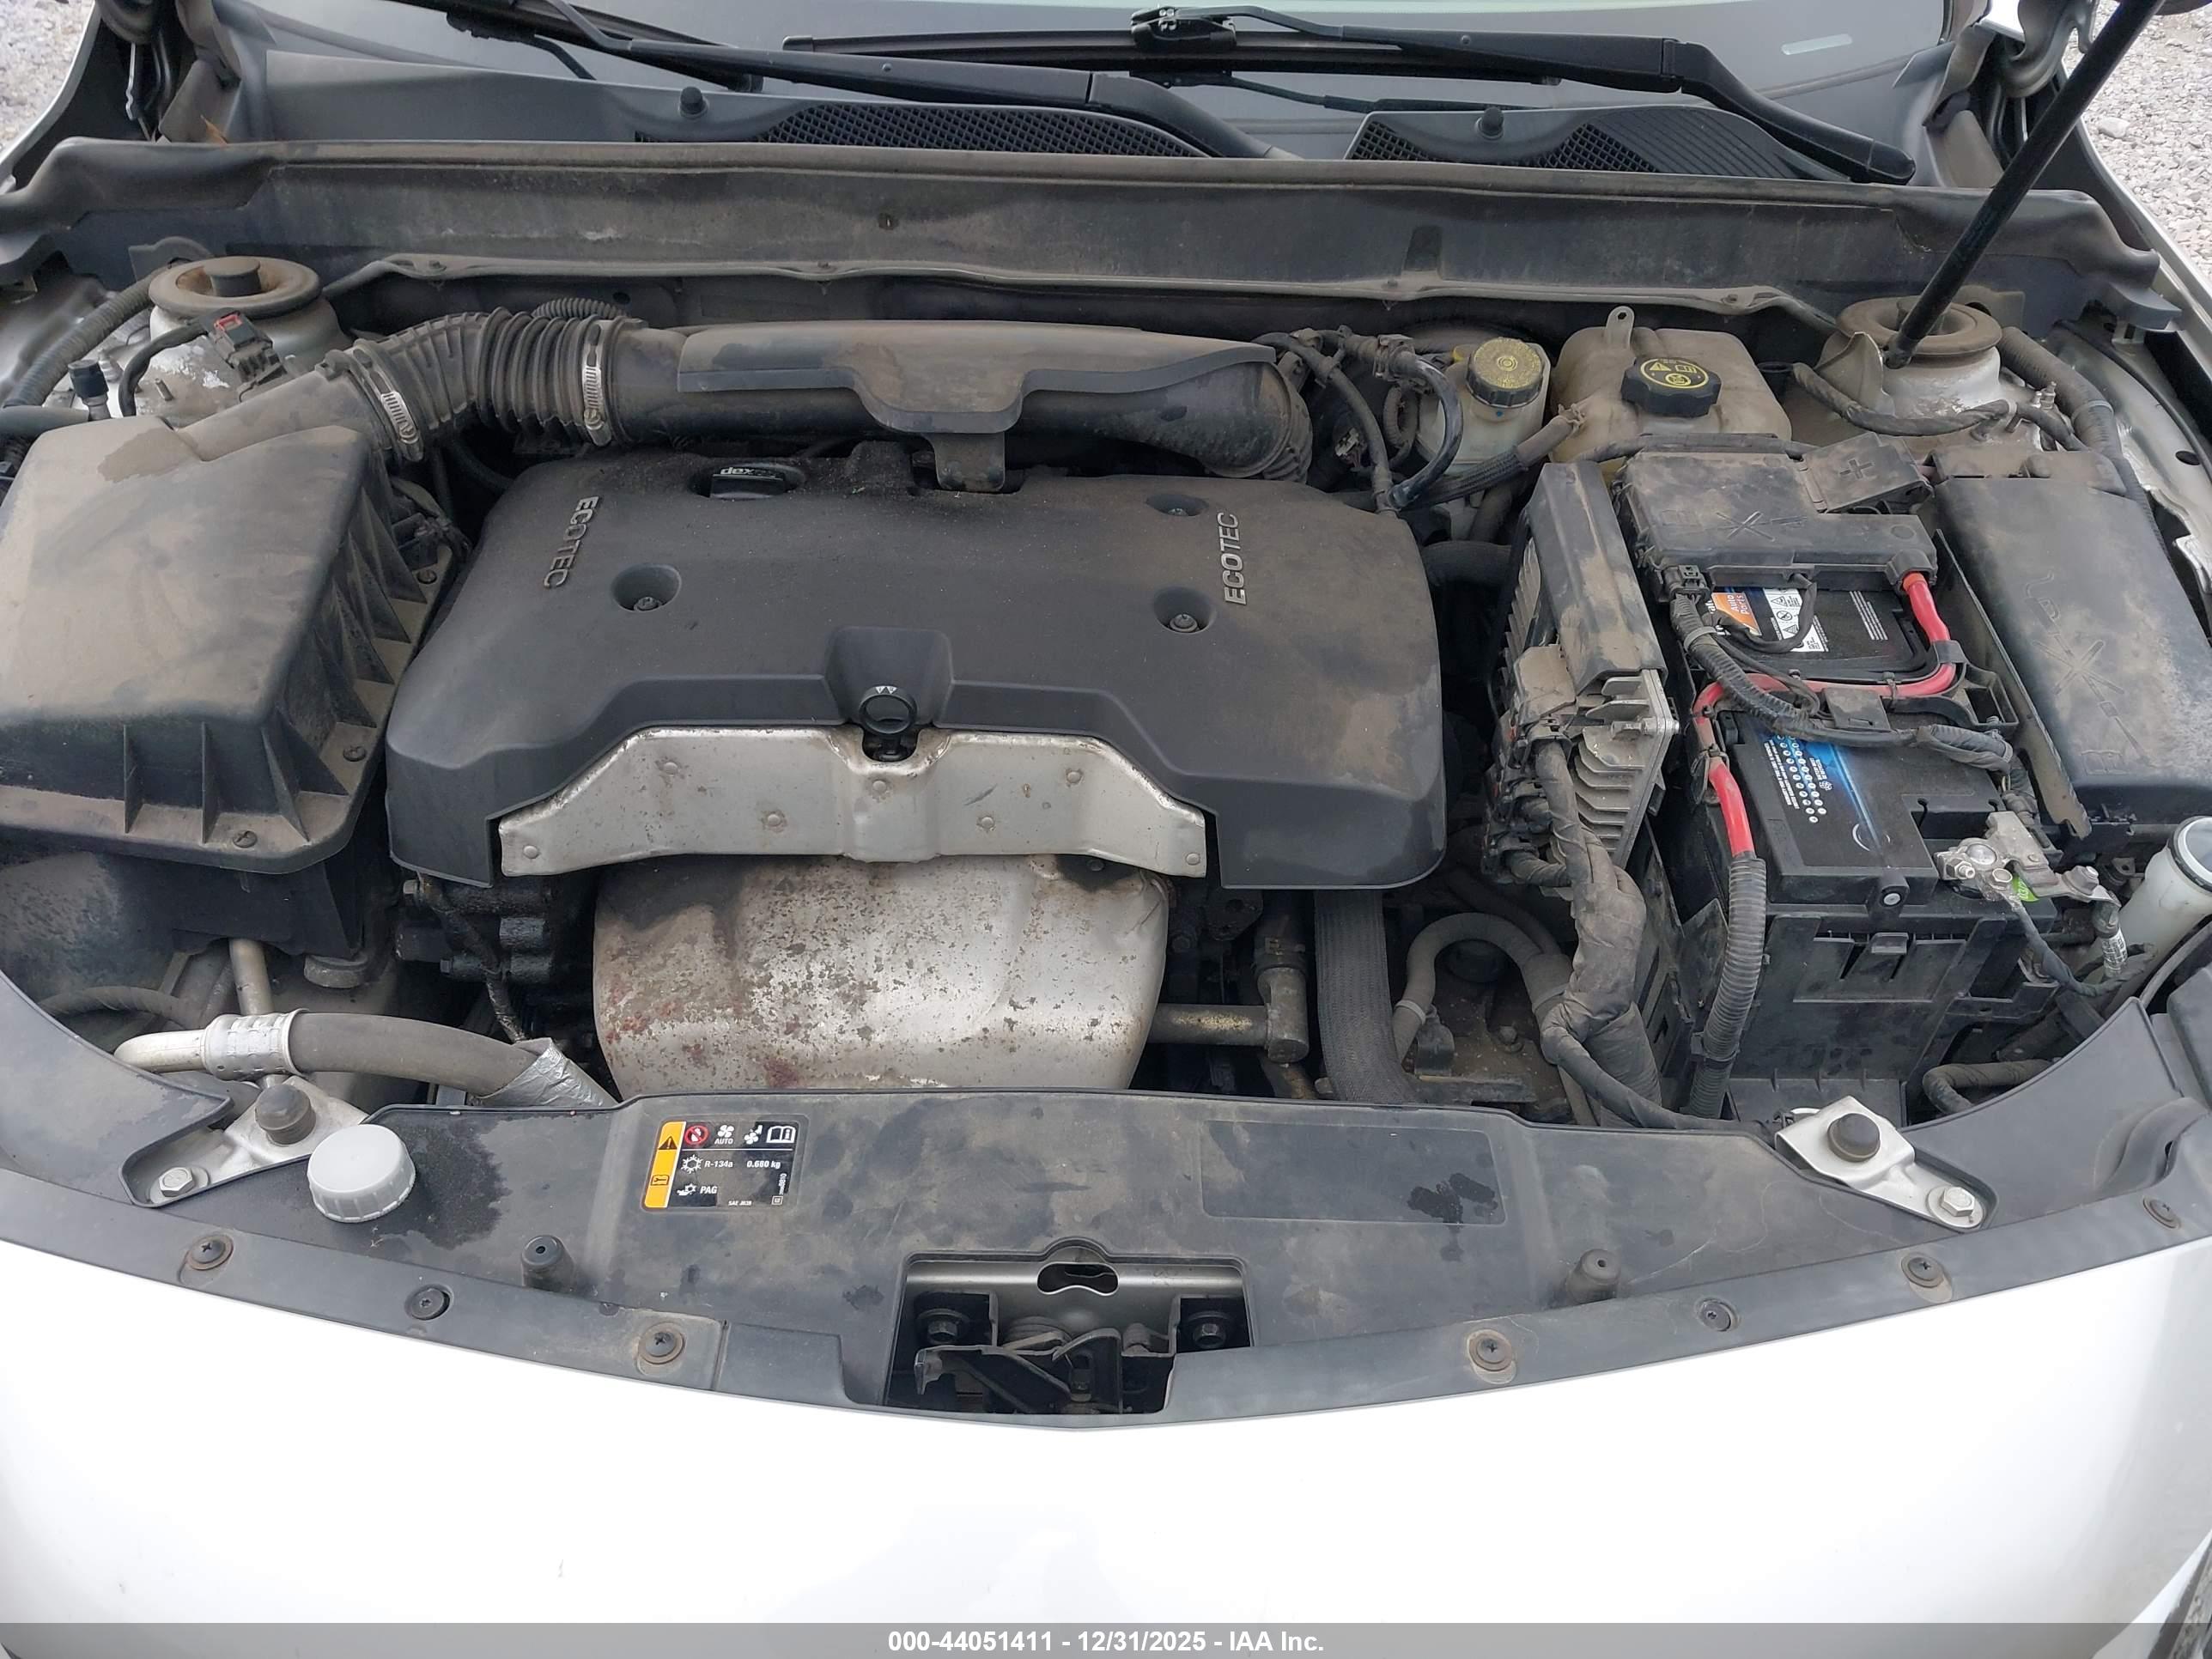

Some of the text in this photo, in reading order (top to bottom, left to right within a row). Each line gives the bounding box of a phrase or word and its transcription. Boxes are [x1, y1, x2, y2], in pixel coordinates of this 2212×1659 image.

[544, 496, 599, 587] ECOTEC
[1217, 512, 1247, 605] ECOTEC
[1727, 594, 1740, 612] Auto
[1735, 594, 1750, 615] Parts
[770, 1160, 781, 1170] kg
[700, 1186, 718, 1194] PAG
